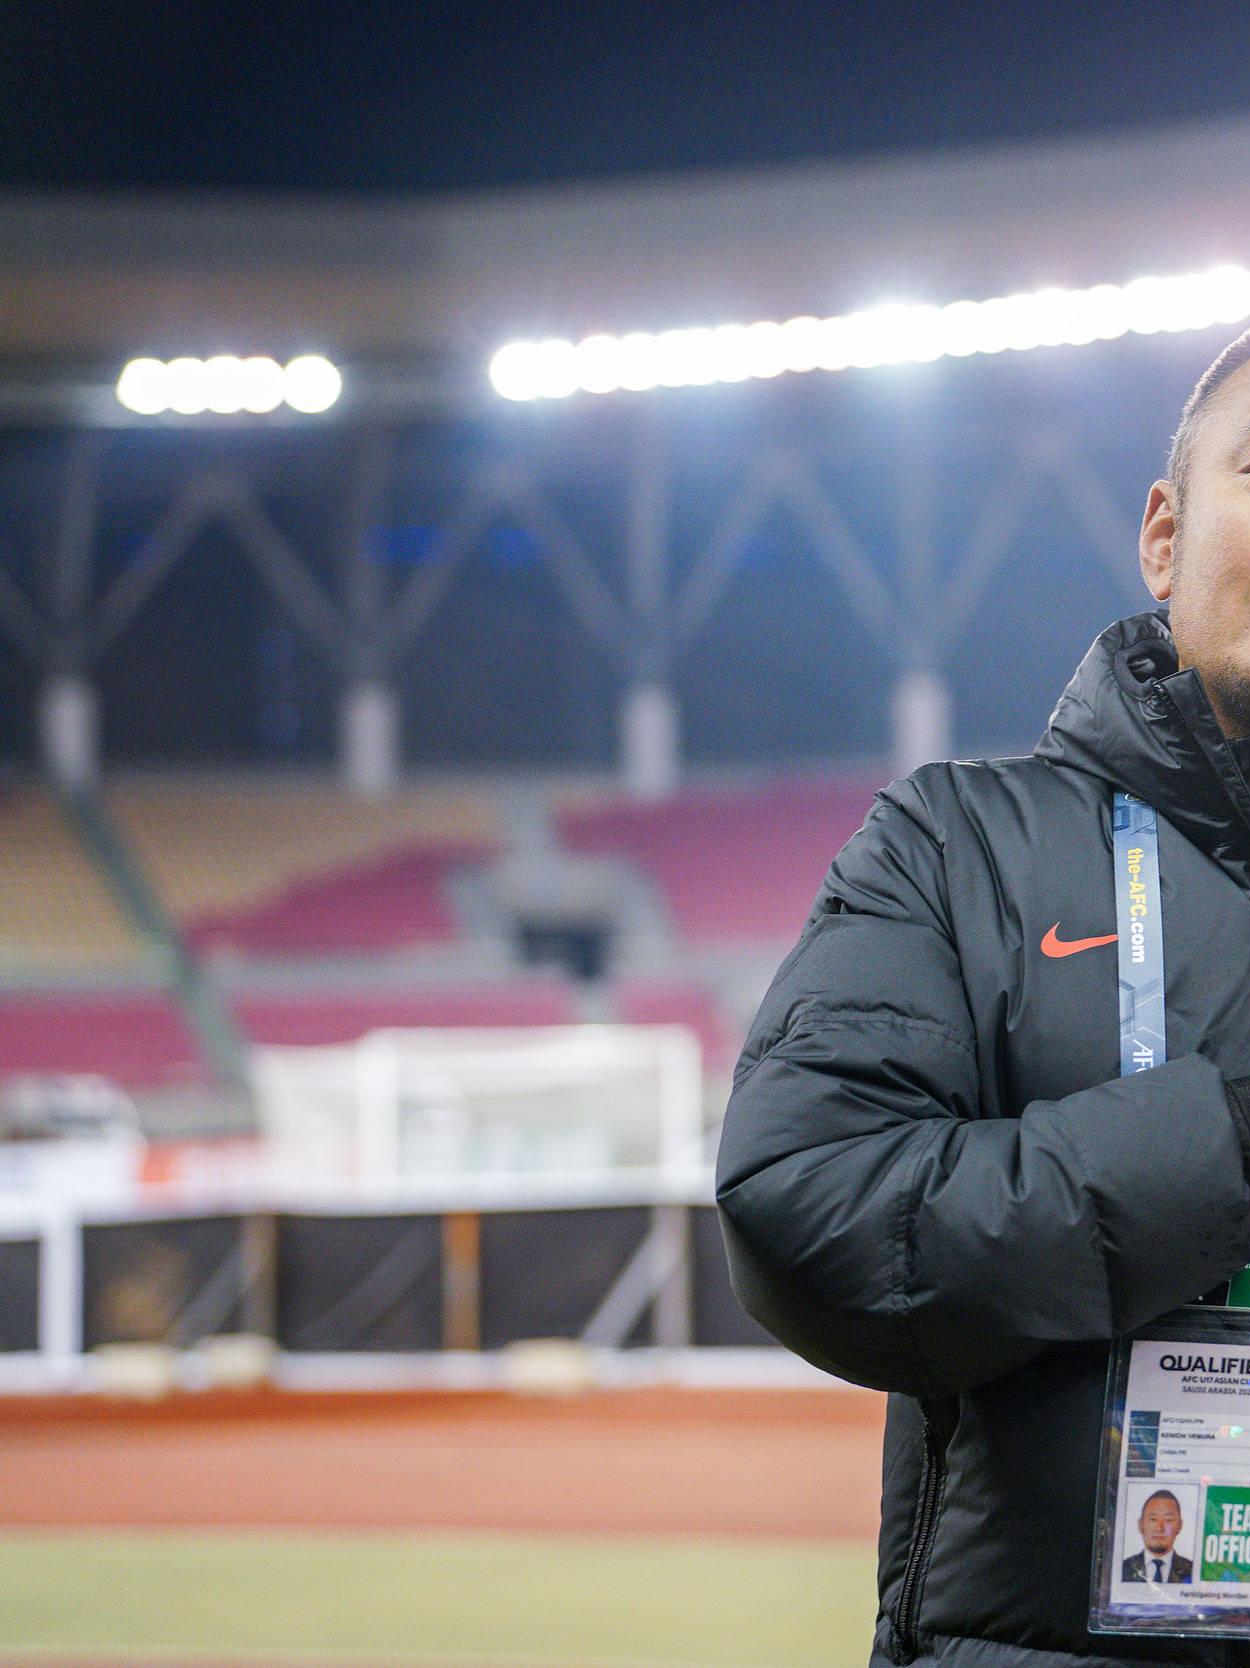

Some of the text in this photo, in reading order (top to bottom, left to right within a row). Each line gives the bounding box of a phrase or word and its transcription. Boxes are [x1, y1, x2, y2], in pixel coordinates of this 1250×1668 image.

[1127, 847, 1147, 964] the-AFC.com
[1132, 1039, 1154, 1073] AF
[1181, 1375, 1198, 1383] AFC
[1214, 1377, 1239, 1385] ASIAN
[1182, 1385, 1206, 1394] SAUDI
[1208, 1387, 1237, 1395] ARABIA
[1180, 1590, 1221, 1599] Participating
[1222, 1591, 1248, 1599] Member
